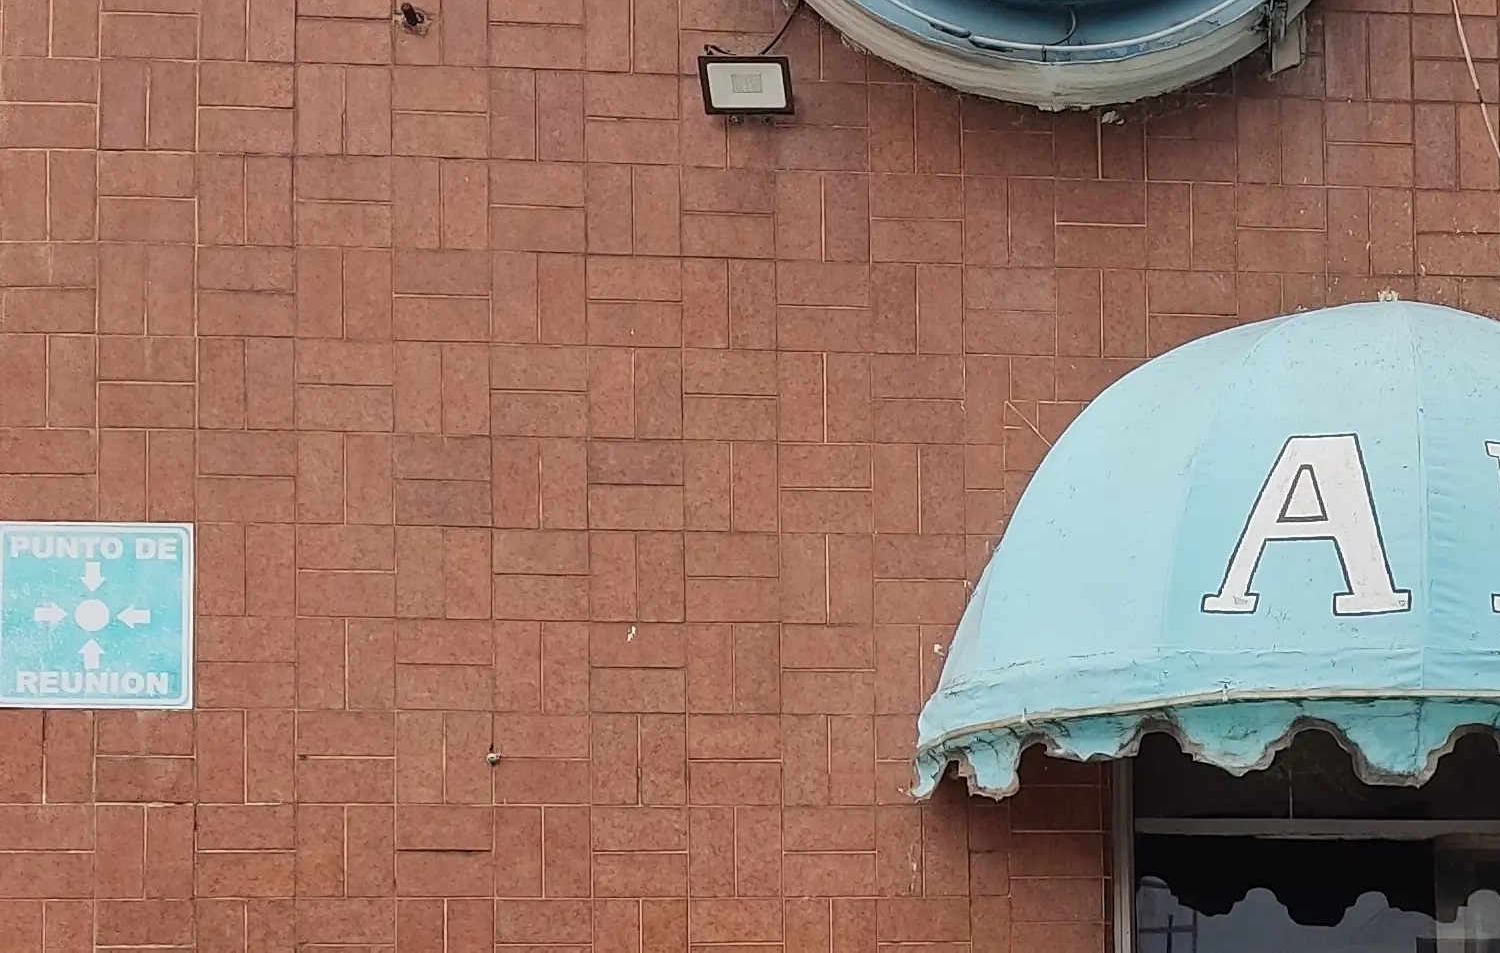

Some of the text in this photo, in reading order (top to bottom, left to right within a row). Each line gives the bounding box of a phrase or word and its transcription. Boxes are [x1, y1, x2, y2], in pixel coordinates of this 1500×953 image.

[10, 535, 178, 560] PUNTO DE
[16, 670, 169, 695] REUNION
